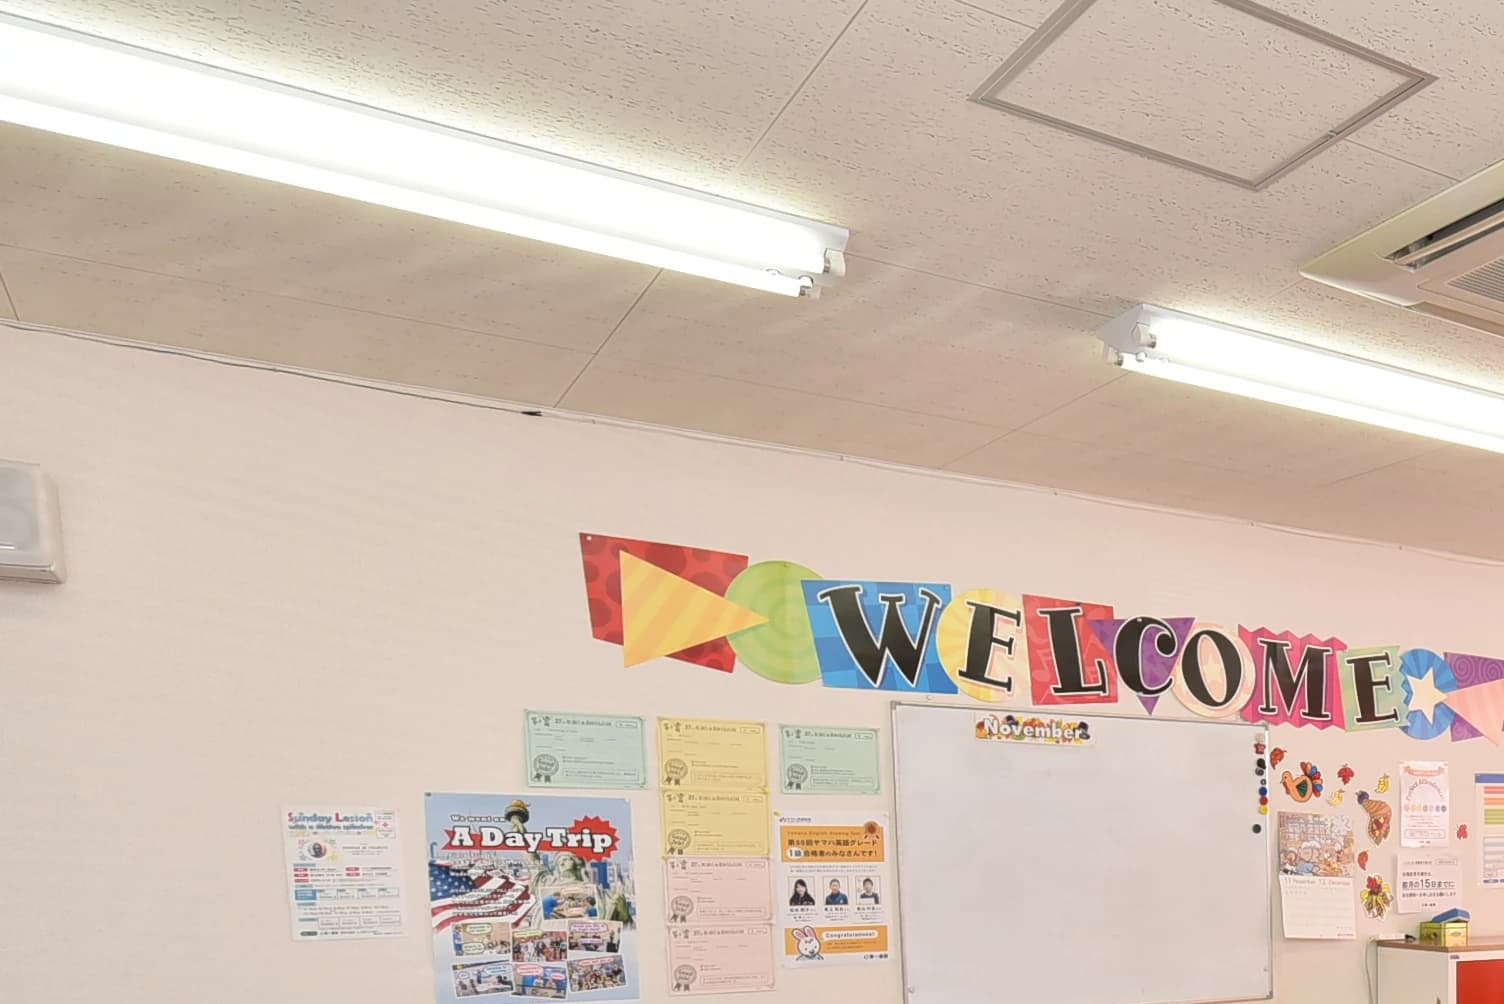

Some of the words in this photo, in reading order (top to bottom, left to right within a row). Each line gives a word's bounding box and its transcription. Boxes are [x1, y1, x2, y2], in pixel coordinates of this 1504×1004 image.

[820, 585, 1399, 726] WELCOME
[983, 717, 1082, 738] November
[288, 812, 332, 823] Sunday
[451, 825, 474, 847] A
[480, 826, 543, 853] Day
[546, 827, 613, 853] Trip
